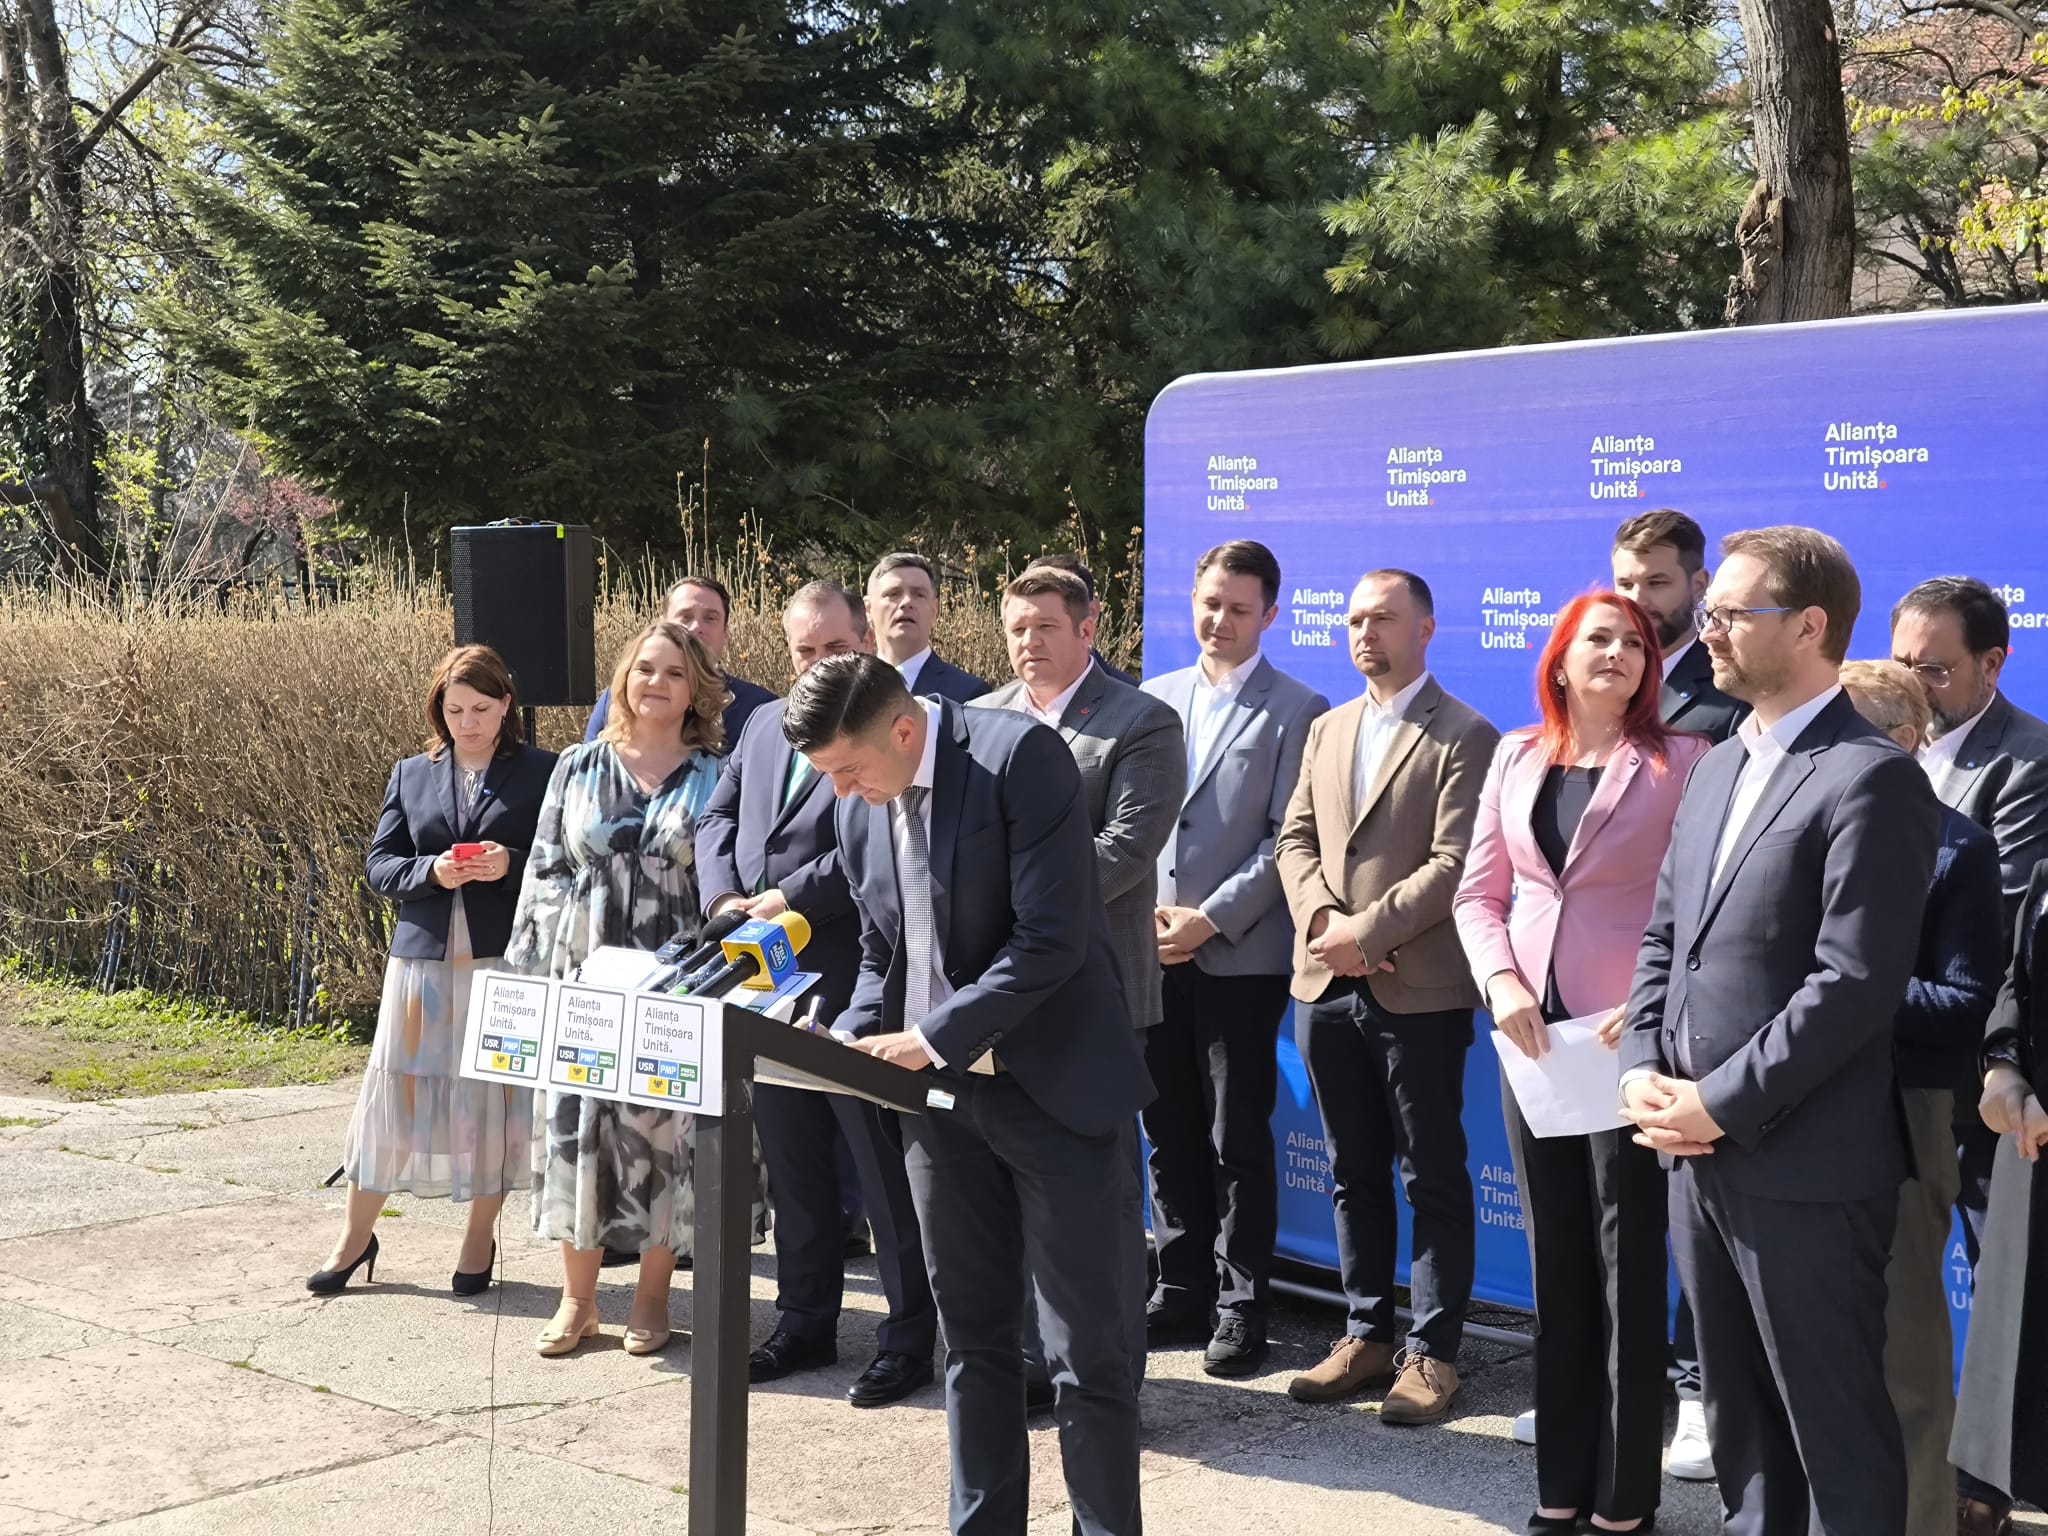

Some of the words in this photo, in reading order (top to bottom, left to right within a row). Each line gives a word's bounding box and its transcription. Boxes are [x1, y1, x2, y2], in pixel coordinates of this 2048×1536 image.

[1824, 421, 1898, 445] Alianța
[1590, 434, 1655, 457] Alianța
[1207, 455, 1257, 475] Alianța
[1386, 446, 1443, 467] Alianța
[1824, 445, 1929, 469] Timișoara
[1590, 456, 1682, 479] Timișoara
[1207, 474, 1278, 495] Timișoara
[1386, 467, 1467, 489] Timișoara
[1823, 470, 1887, 491] Unită.
[1386, 488, 1436, 507] Unită.
[1590, 480, 1646, 500] Unită.
[1207, 494, 1251, 512] Unită.
[1291, 588, 1345, 609] Alianța
[1481, 587, 1541, 609] Alianța
[1291, 609, 1350, 630] Timișoa
[1481, 609, 1560, 631] Timișoar
[1291, 629, 1337, 648] Unită.
[1481, 631, 1533, 650] Unită.
[493, 985, 525, 1001] Alianța
[492, 1000, 537, 1017] Timișoara
[567, 996, 601, 1013] Alianța
[567, 1011, 614, 1029] Timișoara
[644, 1006, 679, 1024] Alianța
[564, 1026, 594, 1042] Unită.
[644, 1022, 693, 1040] Timișoara
[642, 1038, 673, 1054] Unită.
[660, 1065, 677, 1075] PMP
[1286, 1131, 1325, 1151] Alian
[1480, 1164, 1516, 1185] Alia
